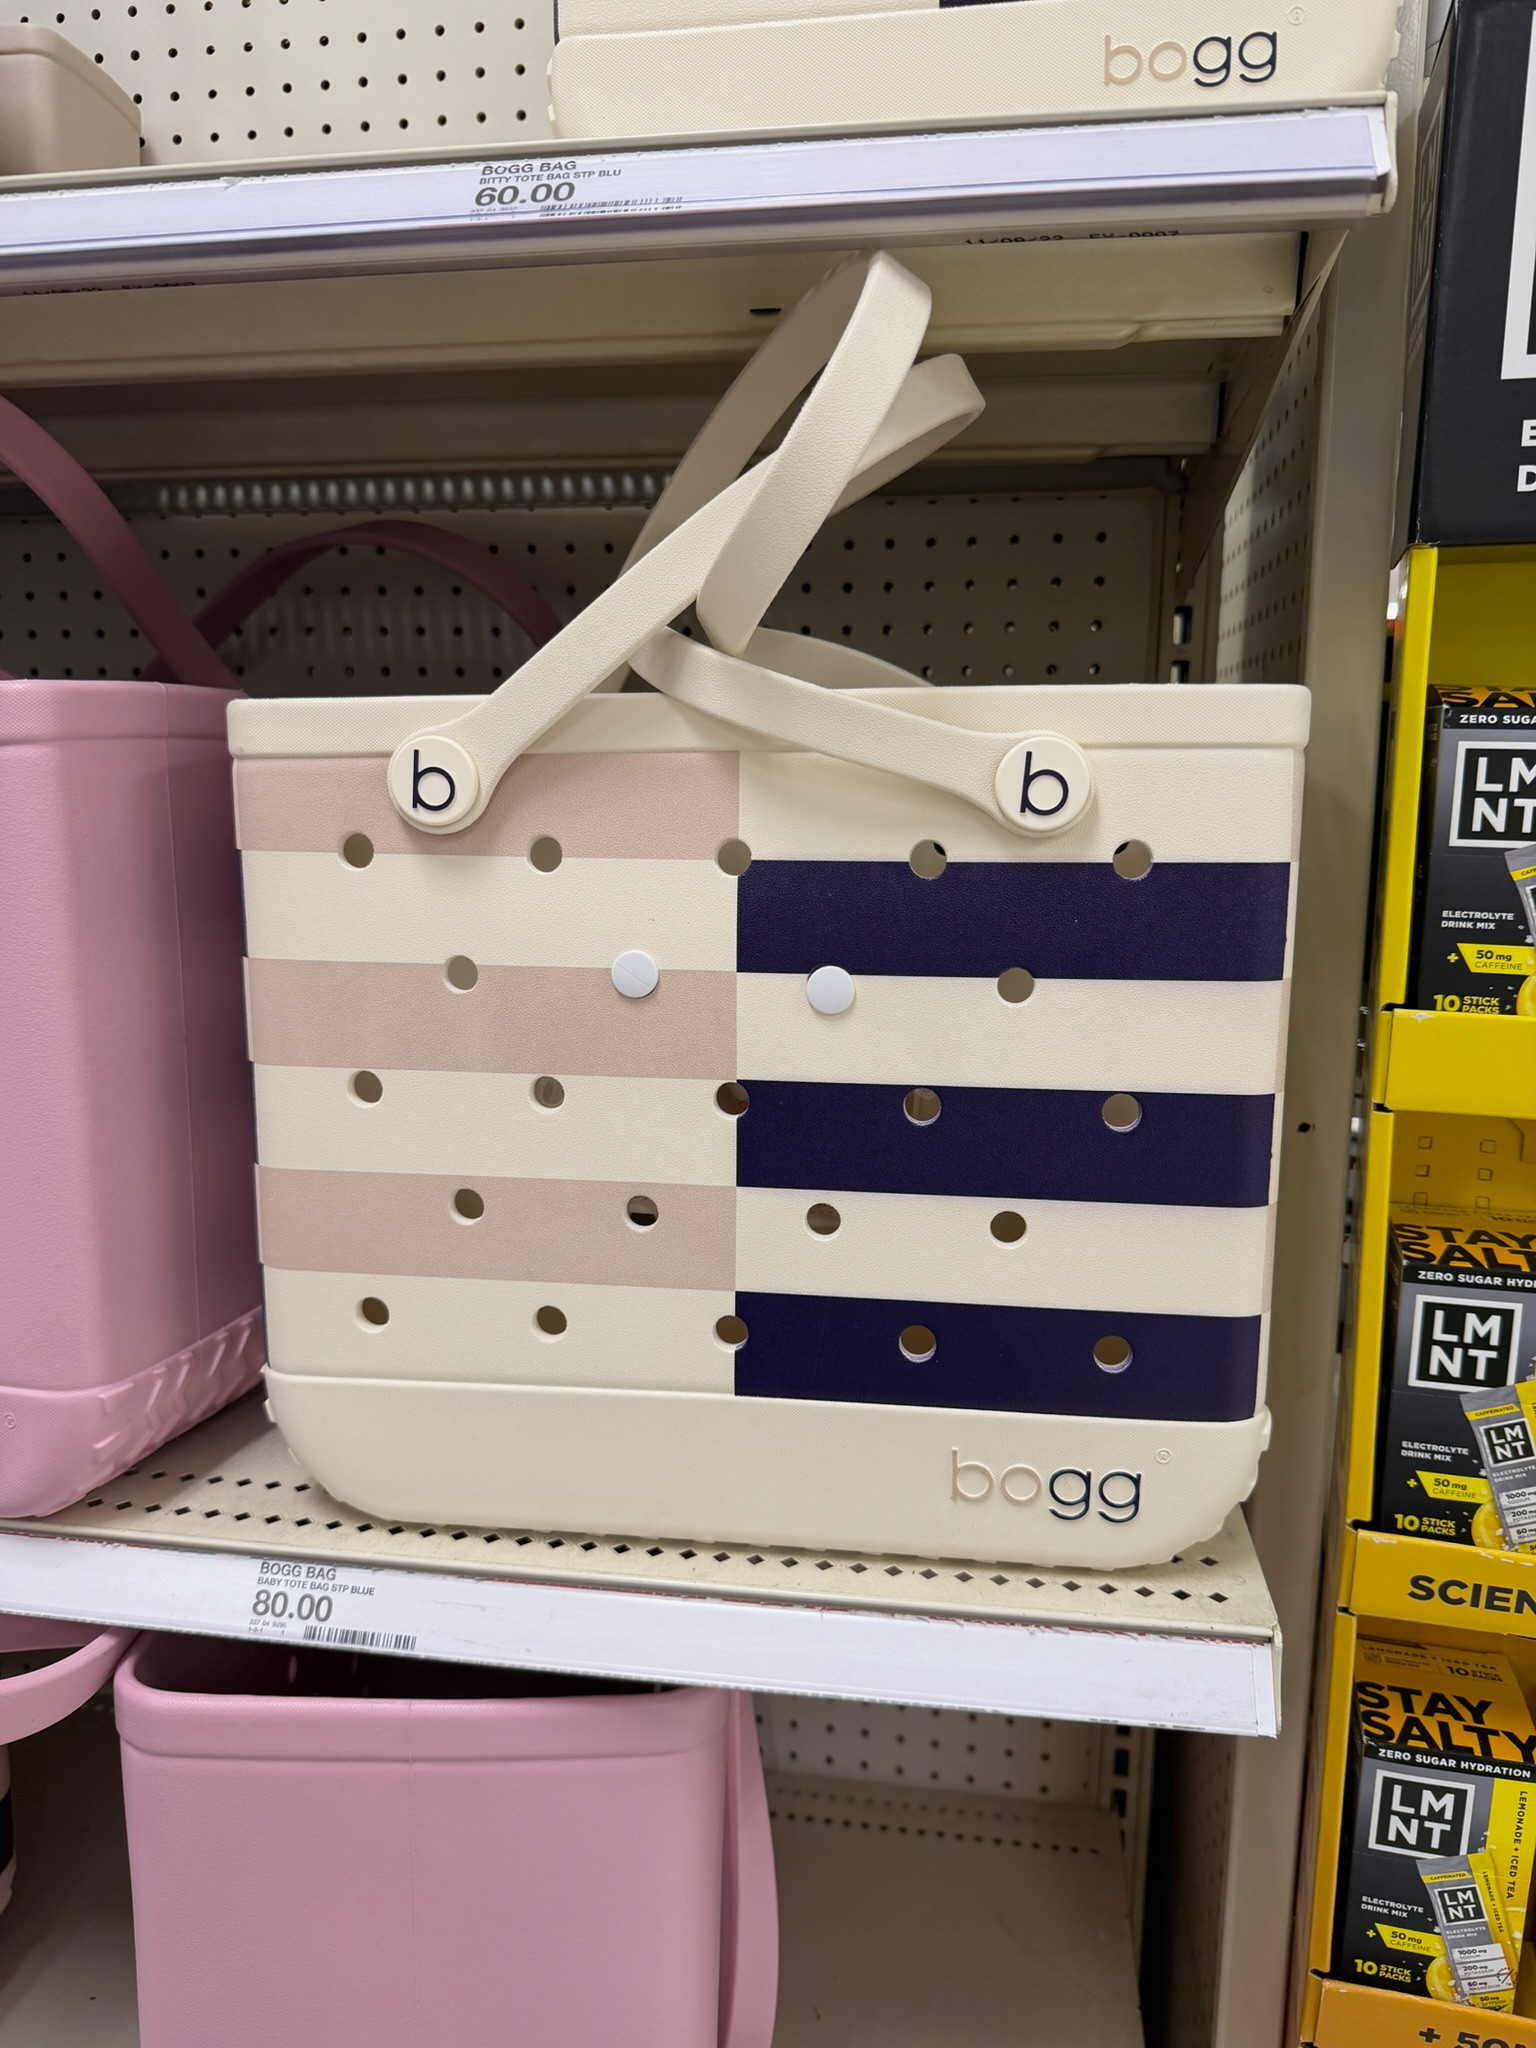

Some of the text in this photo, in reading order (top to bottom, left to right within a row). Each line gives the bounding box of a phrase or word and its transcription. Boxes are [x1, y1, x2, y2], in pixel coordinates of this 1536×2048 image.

[1104, 31, 1277, 88] bogg
[481, 160, 577, 176] BOGG BAG
[479, 169, 622, 185] BITTY TOTE BAG STP BLU
[474, 182, 576, 207] 60.00
[1459, 714, 1498, 724] ZERO
[412, 749, 456, 811] b
[1020, 751, 1069, 816] b
[1441, 910, 1515, 921] ELECTROLYTE
[1441, 920, 1496, 930] DRINK MIX
[1476, 950, 1494, 960] 50
[1495, 953, 1512, 962] mg
[1474, 961, 1523, 971] CAFFEINE
[1433, 994, 1461, 1012] 10
[1463, 995, 1499, 1006] STICK
[1462, 1004, 1499, 1015] PACKS
[1418, 1270, 1454, 1282] ZERO
[1457, 1273, 1503, 1286] SUGAR
[1432, 1309, 1502, 1347] LM
[1428, 1345, 1498, 1381] NT
[1489, 1424, 1524, 1445] LM
[1400, 1449, 1452, 1462] DRINK MIX
[1401, 1440, 1469, 1455] ELECTROLYTE
[1494, 1440, 1526, 1460] NT
[951, 1447, 1142, 1524] bogg
[1433, 1478, 1450, 1488] 50
[1451, 1481, 1467, 1491] mg
[1432, 1487, 1477, 1499] CAFFEINE
[1394, 1513, 1420, 1532] 10
[1420, 1524, 1456, 1536] PACKS
[1422, 1516, 1456, 1529] STICK
[259, 1561, 337, 1581] BOGG BAG
[257, 1576, 376, 1596] BABY TOTE BAG STP BLUE
[252, 1589, 333, 1622] 80.00
[1446, 1665, 1469, 1677] 10
[1356, 1681, 1494, 1725] STAY
[1361, 1710, 1536, 1765] SALTY
[1378, 1748, 1531, 1779] ZERO SUGAR HYDRATION
[1391, 1784, 1455, 1820] LM
[1513, 1791, 1528, 1844] LEMONADE
[1387, 1814, 1451, 1849] NT
[1509, 1855, 1519, 1878] ICED
[1443, 1890, 1475, 1906] LM
[1506, 1881, 1516, 1899] TEA
[1360, 1903, 1408, 1918] DRINK MIX
[1361, 1896, 1424, 1913] ELECTROLYTE
[1448, 1904, 1476, 1920] NT
[1391, 1931, 1407, 1940] 50
[1407, 1936, 1422, 1944] mg
[1390, 1939, 1432, 1953] CAFFEINE
[1354, 1959, 1378, 1975] 10
[1379, 1964, 1412, 1976] STICK
[1379, 1971, 1412, 1983] PACKS
